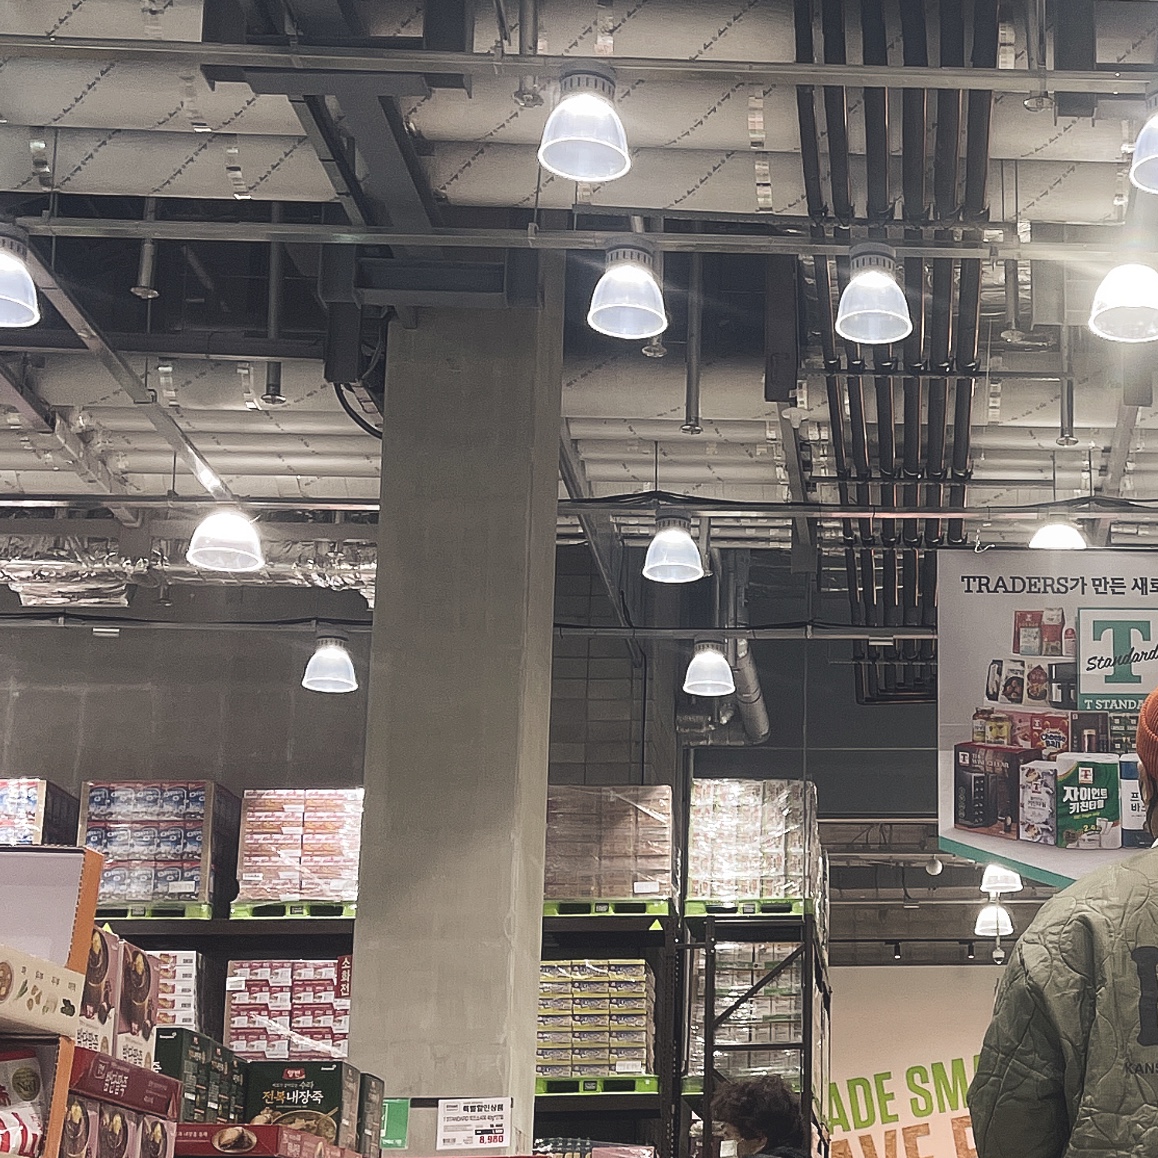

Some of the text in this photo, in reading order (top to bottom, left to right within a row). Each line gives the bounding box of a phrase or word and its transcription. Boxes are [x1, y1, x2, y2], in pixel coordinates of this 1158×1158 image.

[961, 575, 1087, 595] TRADERS가
[1091, 577, 1127, 595] 만든
[1093, 620, 1151, 684] T
[1084, 700, 1093, 709] T
[1063, 786, 1107, 802] 자이언트
[262, 1089, 324, 1105] 전복내장죽
[829, 1055, 980, 1135] ADE SM
[480, 1136, 503, 1144] 8,980
